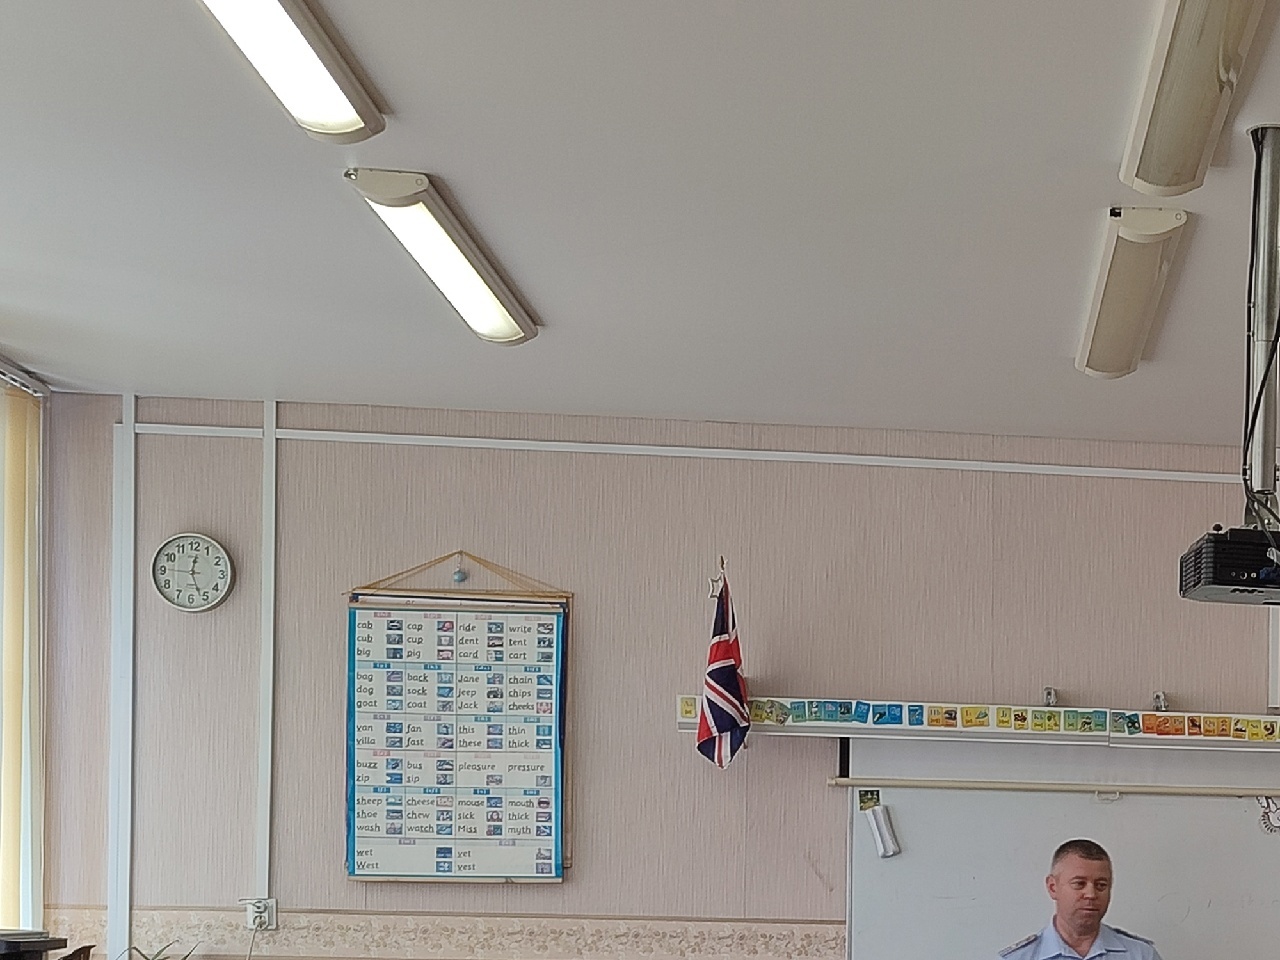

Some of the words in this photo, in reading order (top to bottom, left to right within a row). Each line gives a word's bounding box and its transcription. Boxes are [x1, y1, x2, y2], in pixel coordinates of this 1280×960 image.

[176, 544, 185, 554] 11
[188, 541, 200, 552] 12
[204, 546, 210, 556] 1
[164, 552, 176, 562] 10
[214, 556, 221, 566] 2
[160, 566, 166, 575] 9
[218, 570, 226, 580] 3
[164, 579, 170, 589] 8
[212, 583, 218, 592] 4
[176, 589, 182, 599] 7
[202, 591, 209, 601] 5
[188, 594, 194, 604] 6
[357, 621, 372, 630] cab
[407, 624, 423, 632] cap
[459, 623, 476, 632] ride
[508, 625, 532, 634] write
[357, 634, 372, 643] cub
[407, 636, 423, 644] cup
[458, 637, 479, 645] dent
[357, 648, 370, 660] big
[407, 649, 421, 659] pig
[459, 650, 478, 659] card
[508, 652, 527, 660] cart
[357, 672, 373, 682] bag
[408, 674, 428, 682] back
[508, 676, 532, 684] chain
[356, 685, 374, 695] dog
[408, 687, 427, 696] sock
[457, 688, 476, 698] jeep
[508, 690, 532, 698] chips
[356, 700, 378, 708] goat
[458, 702, 478, 710] Jack
[406, 724, 422, 734] fan
[458, 726, 474, 734] this
[508, 726, 526, 734] thin
[406, 737, 424, 747] fast
[508, 740, 530, 748] thick
[356, 761, 378, 769] buzz
[407, 762, 422, 770] bus
[458, 762, 496, 772] pleasure
[356, 774, 370, 782] zip
[356, 797, 382, 806] sheep
[406, 797, 435, 805] cheese
[508, 800, 534, 808] mouth
[407, 811, 430, 819] chew
[458, 812, 474, 820] sick
[508, 812, 529, 820] thick
[356, 824, 380, 832] wash
[407, 824, 434, 832] watch
[458, 826, 477, 834] Miss
[508, 826, 531, 834] myth
[356, 861, 379, 869] West
